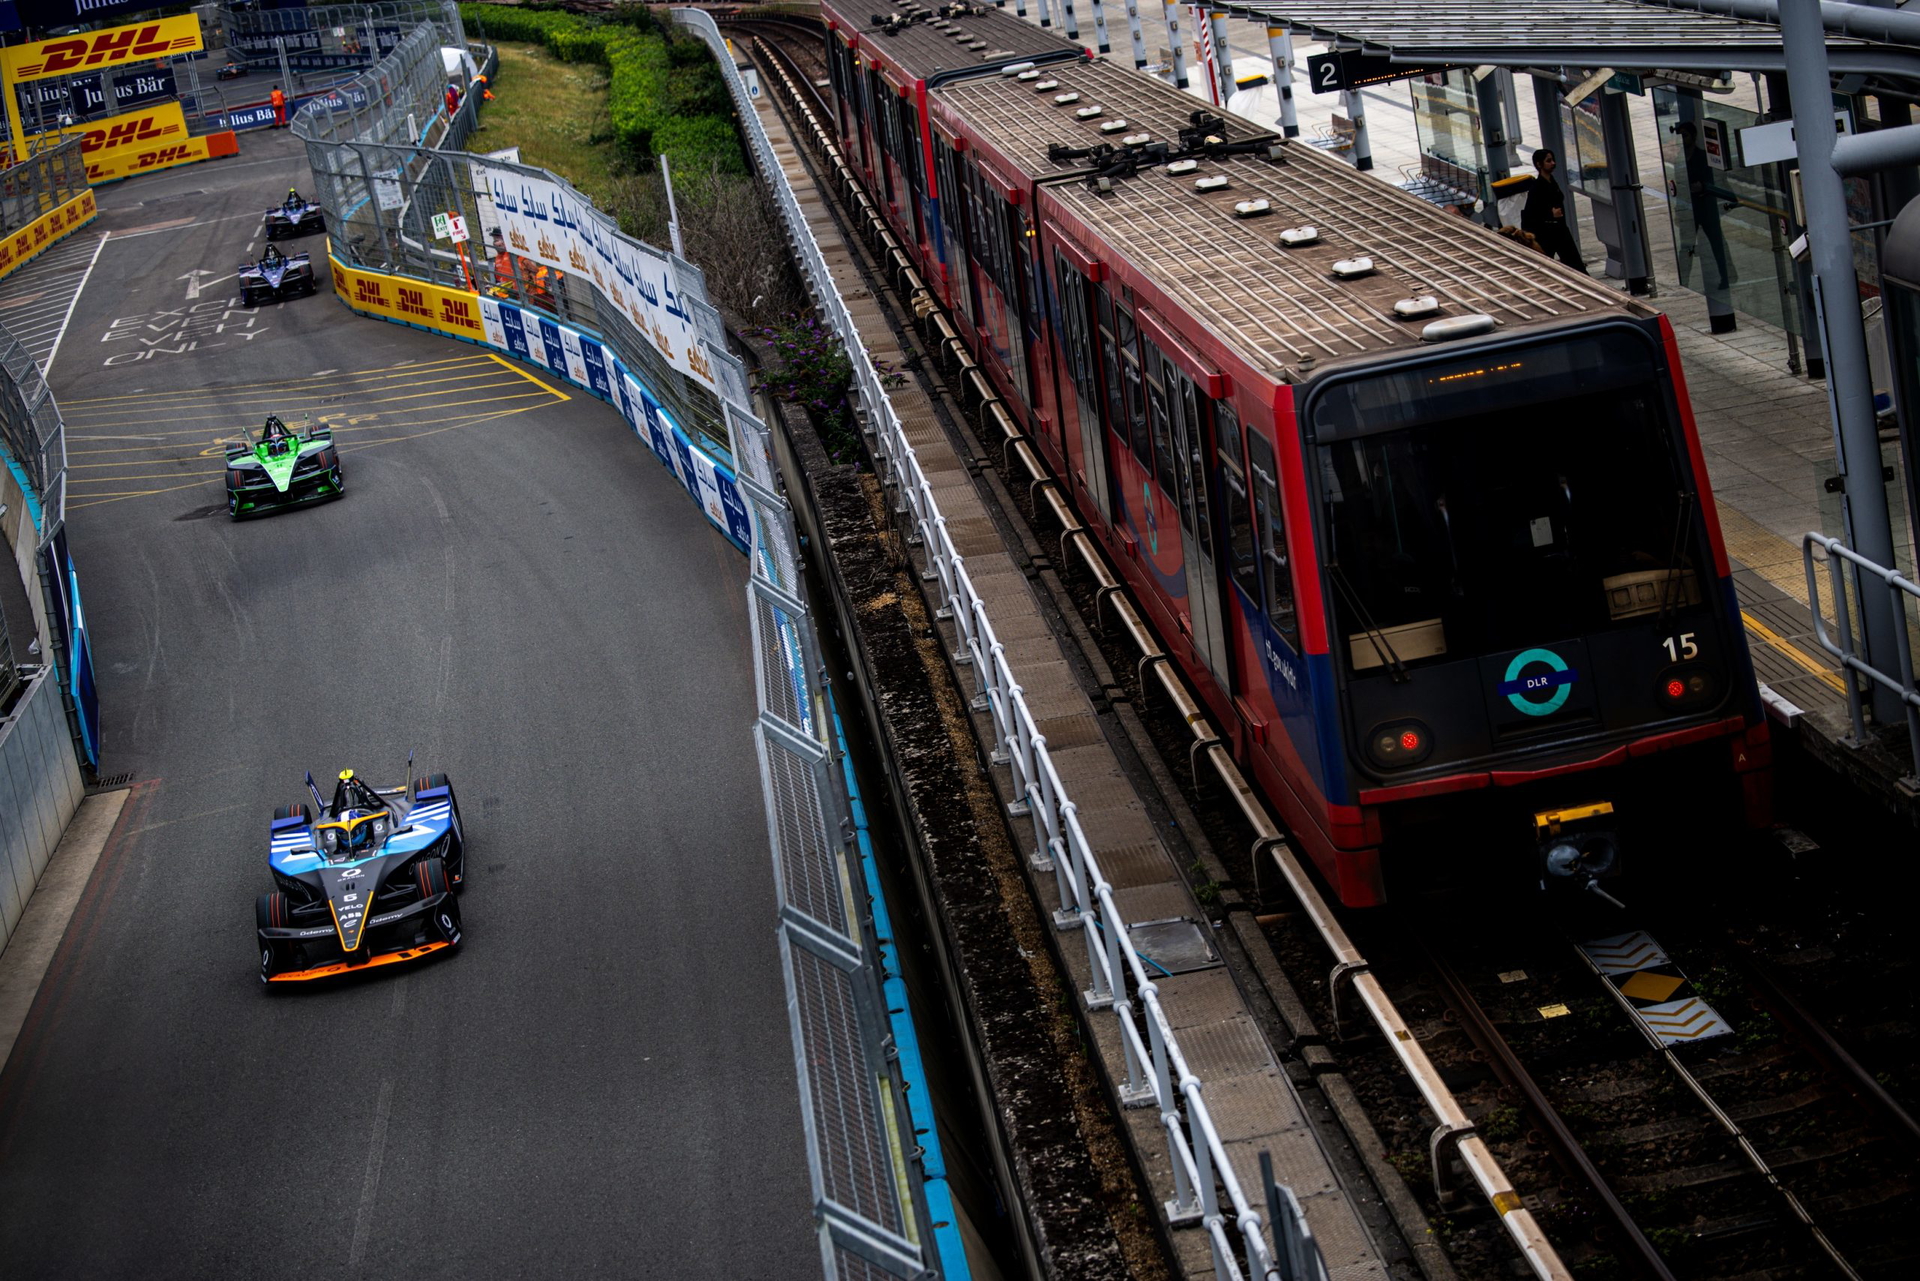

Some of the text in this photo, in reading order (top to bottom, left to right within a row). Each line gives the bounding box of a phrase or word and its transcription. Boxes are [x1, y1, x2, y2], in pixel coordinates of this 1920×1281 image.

[41, 25, 171, 73] DHL
[1320, 62, 1337, 86] 2
[84, 76, 166, 108] Juus Bär
[81, 117, 163, 153] DHL
[138, 145, 192, 168] DHL
[357, 279, 385, 306] DHL
[398, 288, 428, 317] DHL
[442, 298, 474, 328] DHL
[103, 327, 270, 366] ONLY
[1663, 632, 1699, 662] 15
[1527, 677, 1548, 688] DLR
[1738, 753, 1746, 763] A
[338, 903, 363, 911] VELO
[339, 912, 362, 921] ABB
